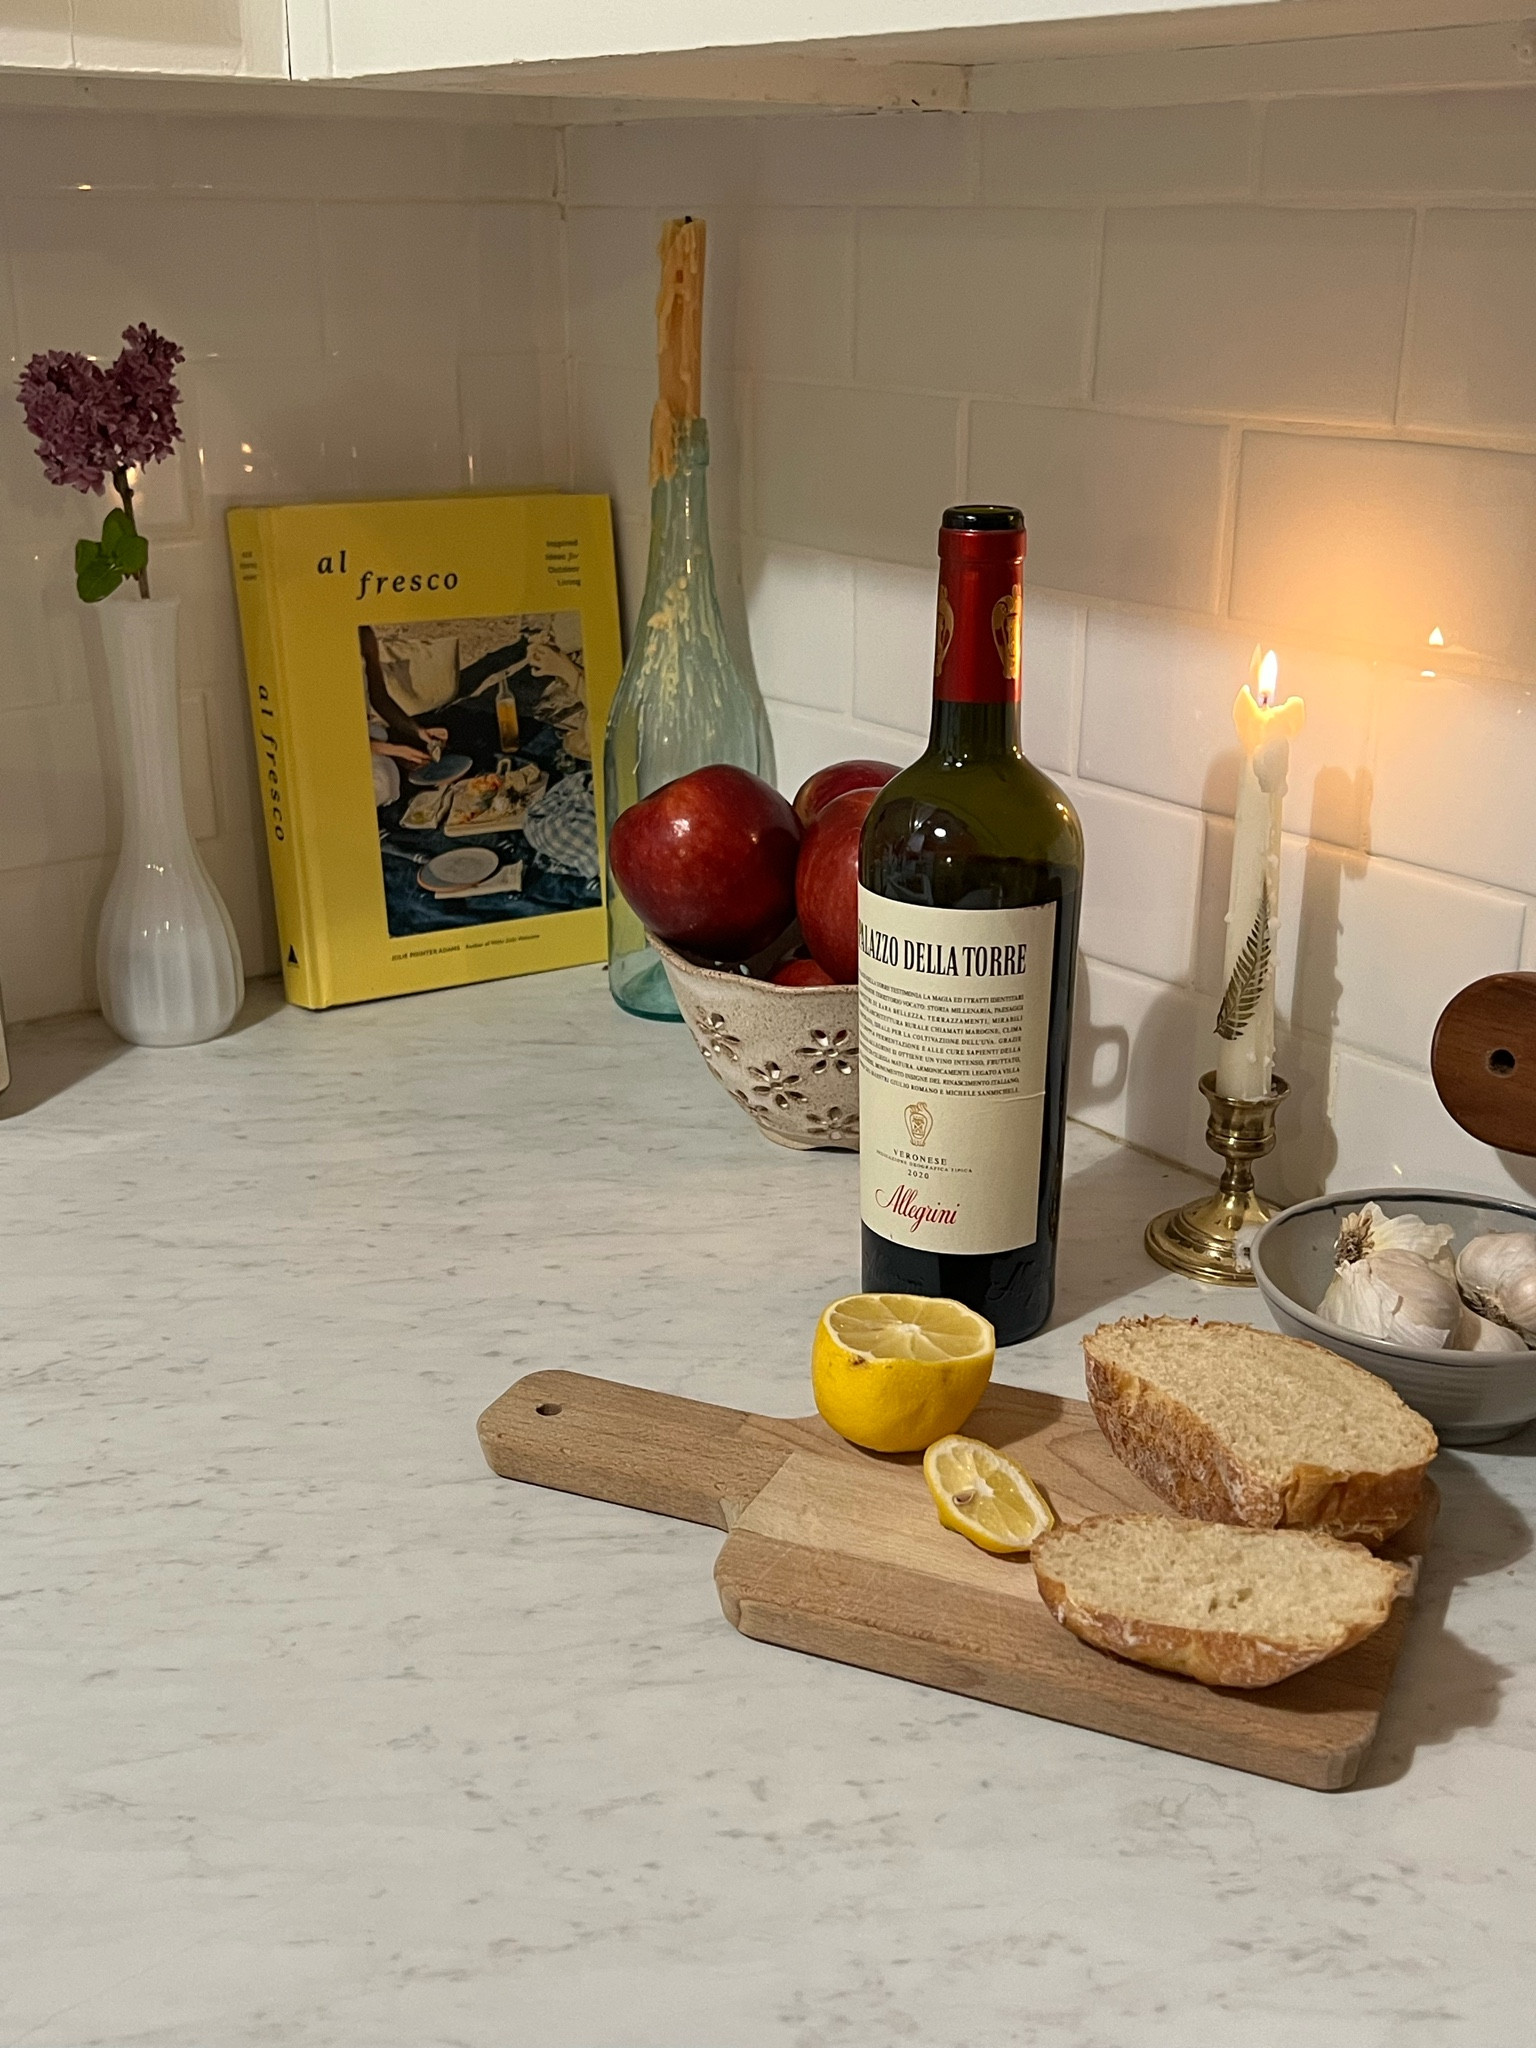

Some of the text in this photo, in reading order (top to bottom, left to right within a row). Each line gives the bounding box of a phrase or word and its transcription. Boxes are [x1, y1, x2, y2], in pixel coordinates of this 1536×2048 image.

[317, 549, 346, 574] al
[355, 571, 458, 601] fresco
[258, 685, 285, 842] al fresco
[904, 939, 959, 977] DELLA
[962, 944, 1027, 977] TORRE
[932, 995, 953, 1003] MAGIA
[927, 1005, 949, 1013] STORIA
[992, 1015, 1023, 1024] MIRABILI
[905, 1021, 929, 1032] RURALE
[931, 1026, 964, 1034] CHIAMATI
[891, 1027, 903, 1036] PER
[912, 1034, 960, 1045] COLTIVAZIONE
[998, 1036, 1022, 1044] GRAZIE
[898, 1050, 924, 1061] OTTIENE
[935, 1057, 953, 1065] VINO
[999, 1046, 1021, 1055] DELLA
[916, 1065, 970, 1076] ARMONICAMENTE
[910, 1085, 938, 1094] ROMANO
[893, 1148, 948, 1166] VERONESE
[907, 1168, 930, 1180] 2020
[875, 1184, 961, 1233] Allegrini
